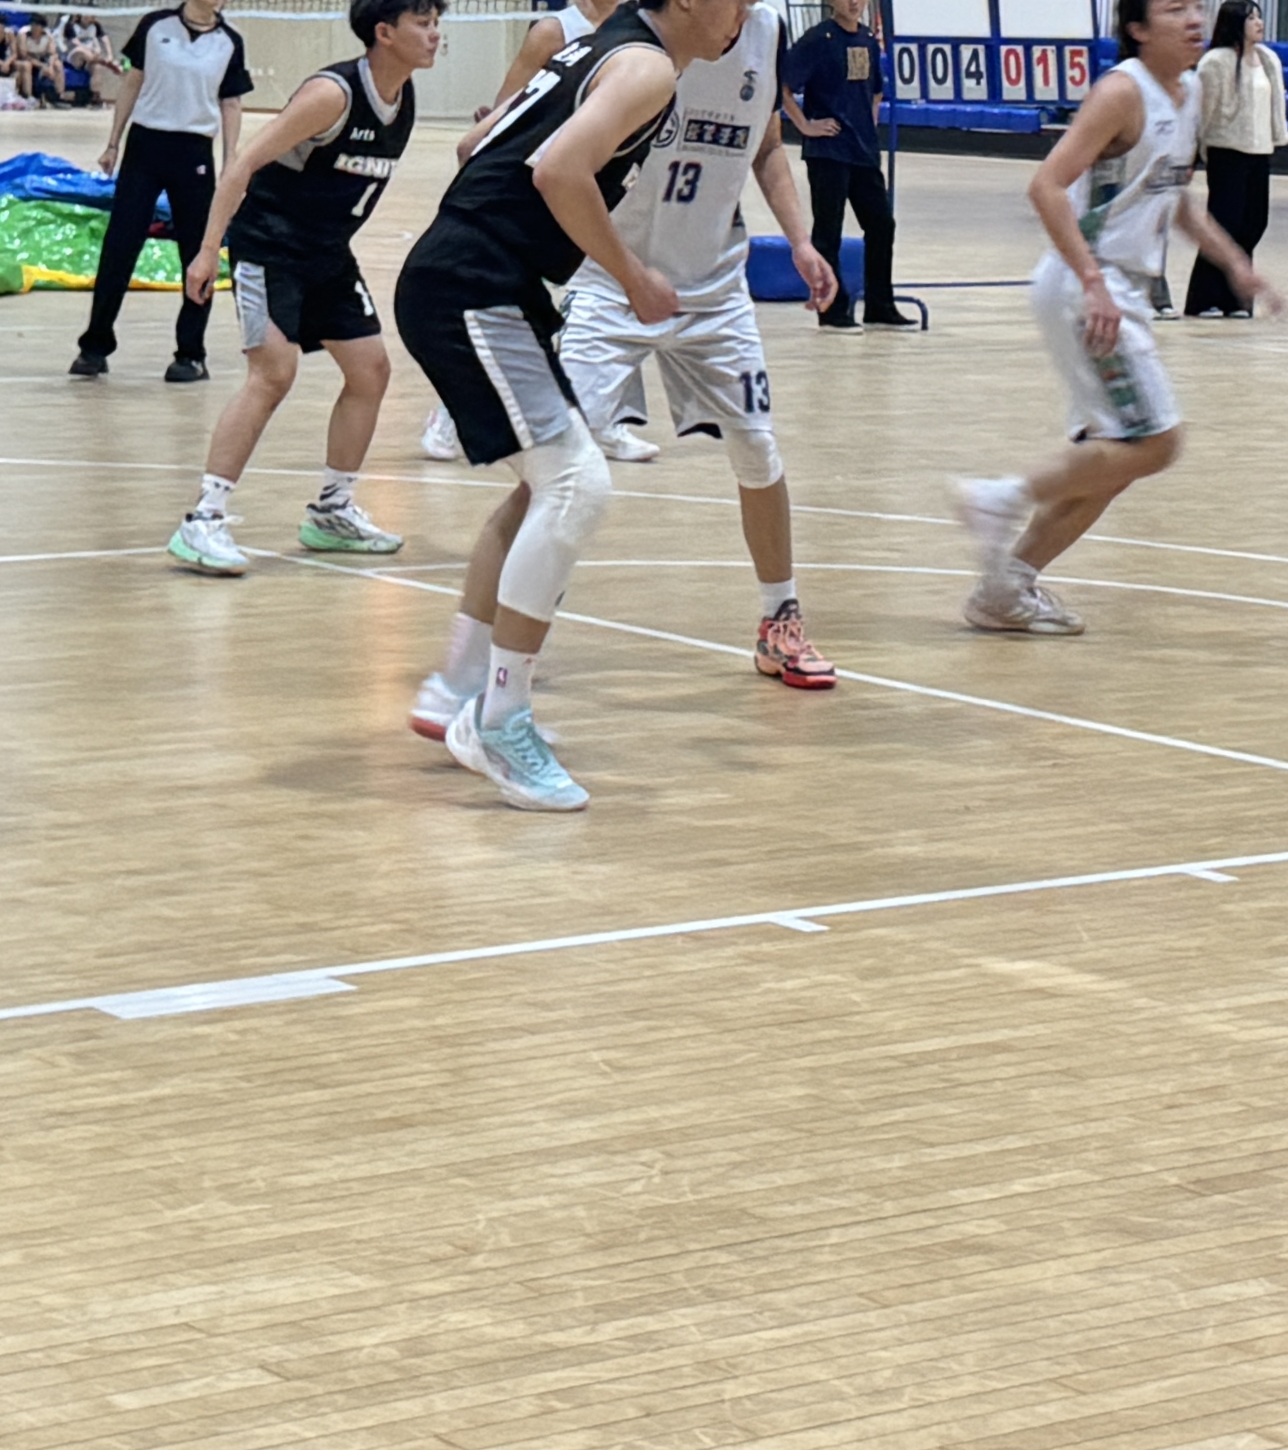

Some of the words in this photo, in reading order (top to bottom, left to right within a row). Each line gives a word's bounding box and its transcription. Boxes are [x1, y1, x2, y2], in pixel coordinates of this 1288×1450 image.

[350, 127, 375, 141] Arts
[333, 153, 398, 178] IGNI
[662, 160, 702, 205] 13
[738, 370, 771, 413] 13
